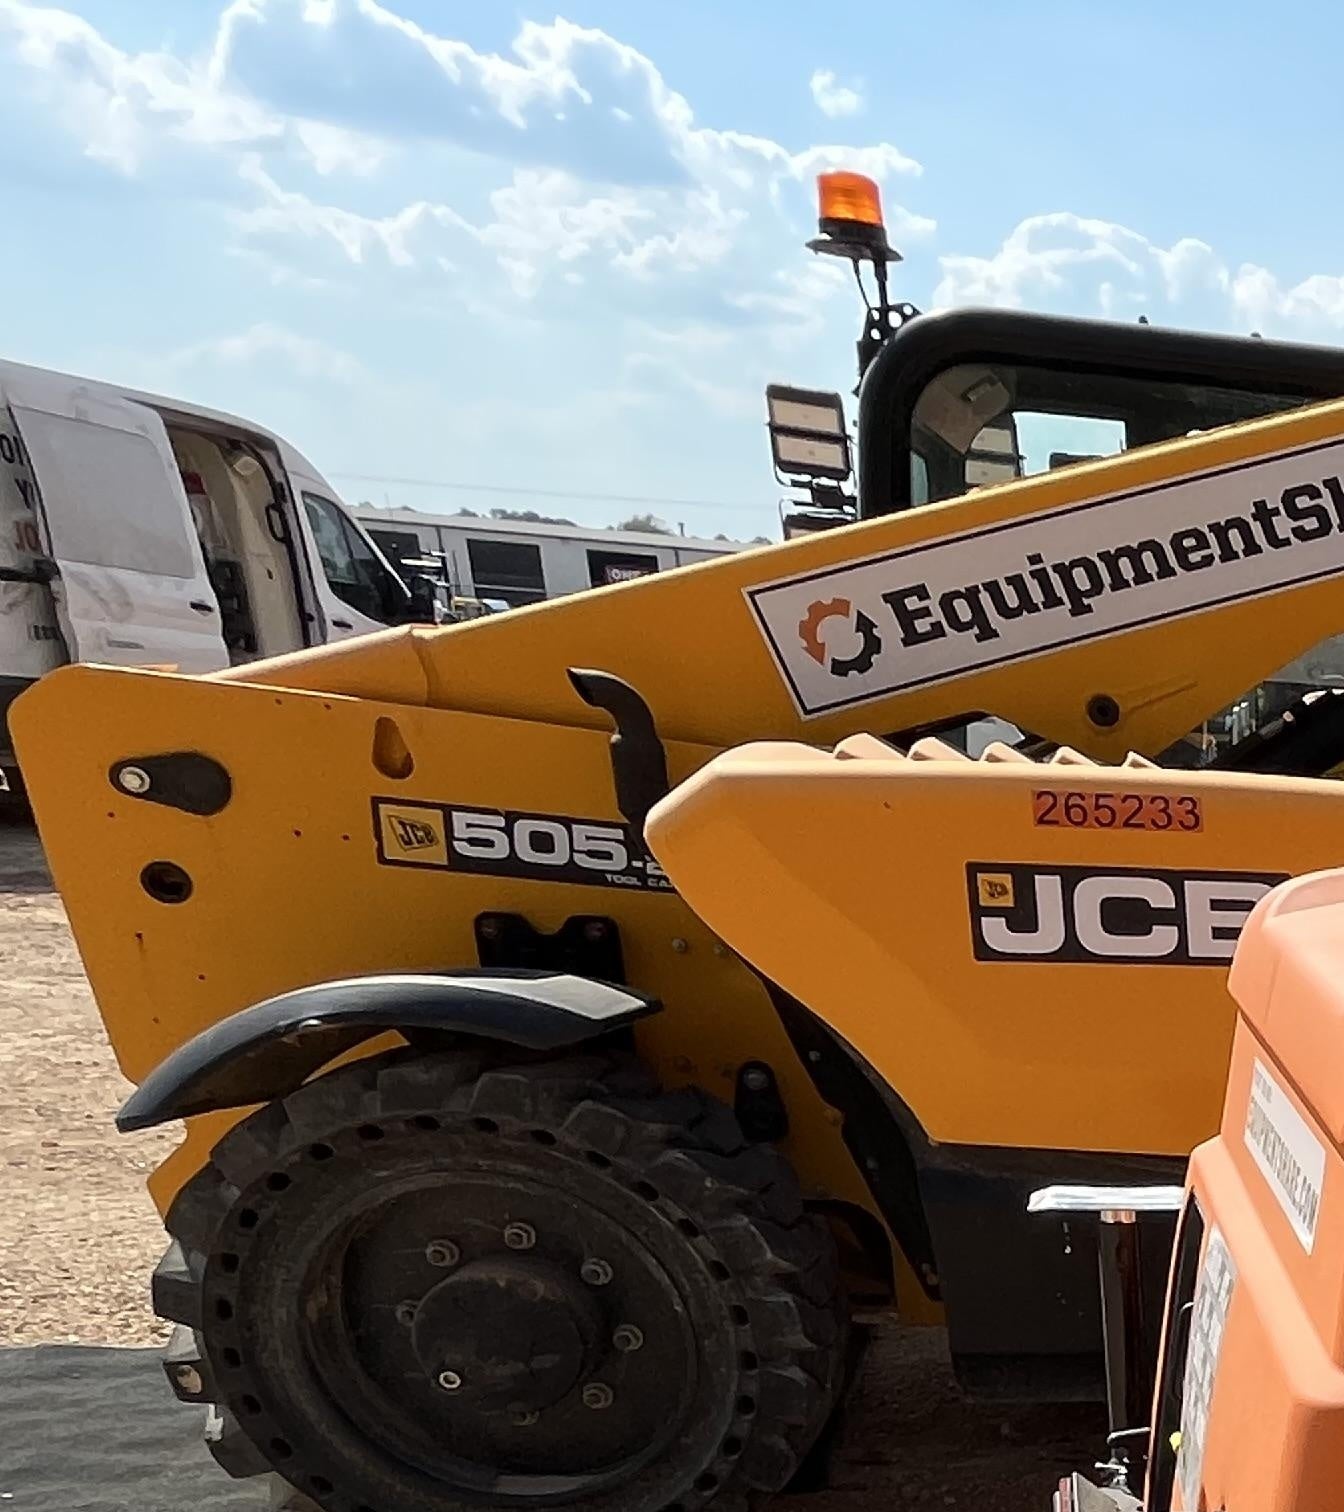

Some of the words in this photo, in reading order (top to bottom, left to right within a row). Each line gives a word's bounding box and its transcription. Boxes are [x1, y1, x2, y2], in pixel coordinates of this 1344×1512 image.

[1036, 790, 1200, 830] 265233
[390, 815, 437, 851] JCB
[981, 874, 1274, 957] JCB
